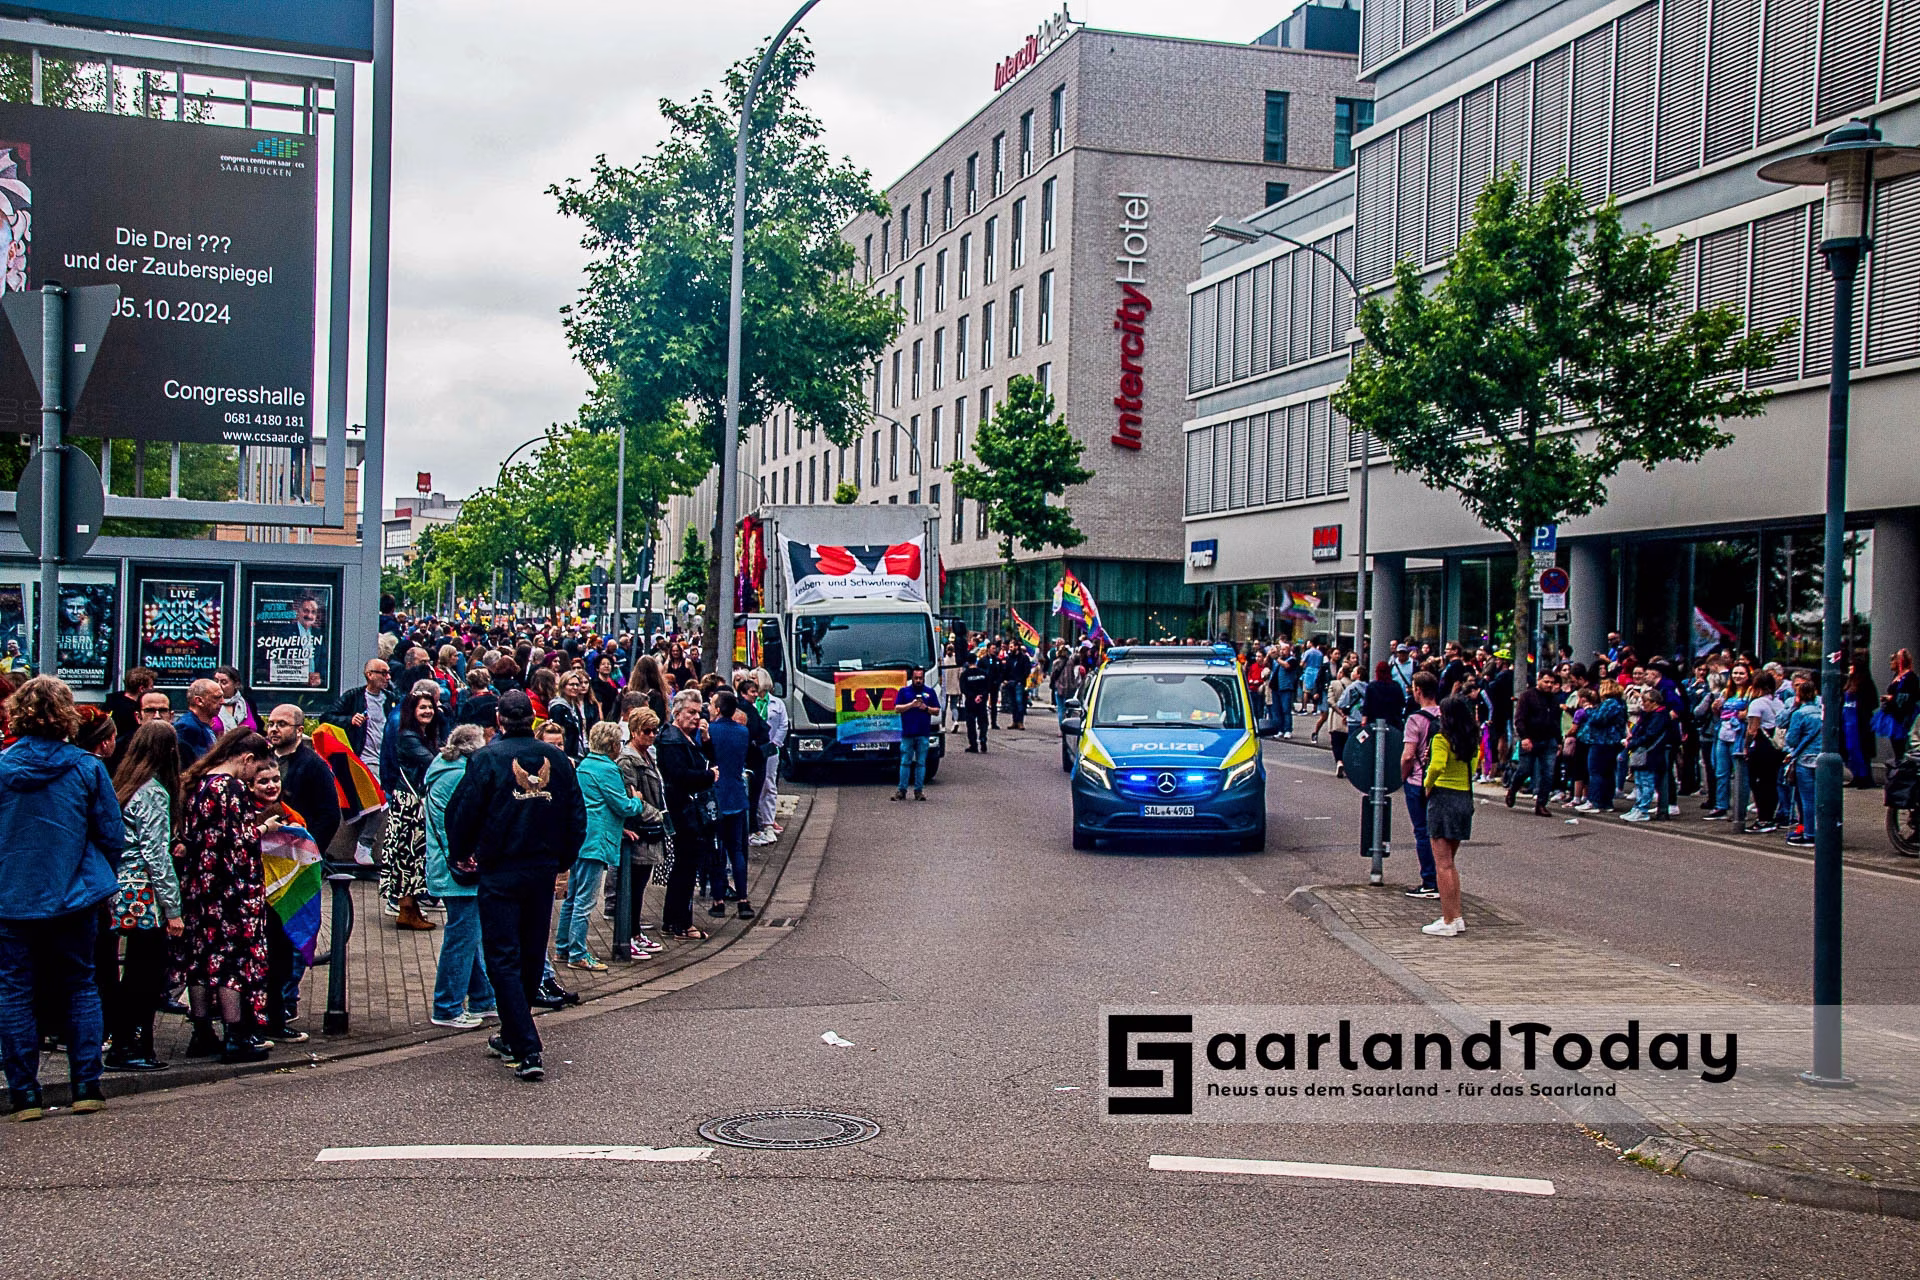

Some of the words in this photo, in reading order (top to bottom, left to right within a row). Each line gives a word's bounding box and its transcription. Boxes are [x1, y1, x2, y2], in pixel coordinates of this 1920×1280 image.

[220, 155, 249, 163] congress
[250, 158, 276, 166] centrum
[116, 227, 147, 247] Die
[153, 230, 191, 250] Drei
[198, 234, 231, 253] ???
[64, 253, 100, 270] und
[106, 255, 137, 272] der
[142, 256, 273, 286] Zauberspiegel
[164, 380, 305, 406] Congresshalle
[224, 412, 251, 424] 0681
[254, 413, 282, 426] 4180
[285, 415, 304, 427] 181
[223, 430, 304, 444] www.ccsaar.de
[1535, 526, 1550, 547] P
[828, 578, 847, 587] und
[170, 590, 196, 599] LIVE
[153, 597, 213, 623] ROCK
[150, 620, 213, 644] AGES
[266, 648, 285, 660] IST
[145, 654, 216, 669] SAARBRÜCKEN
[58, 667, 104, 675] BÖHMERMANN
[1131, 742, 1205, 752] POLIZEI
[1145, 806, 1160, 815] SAL
